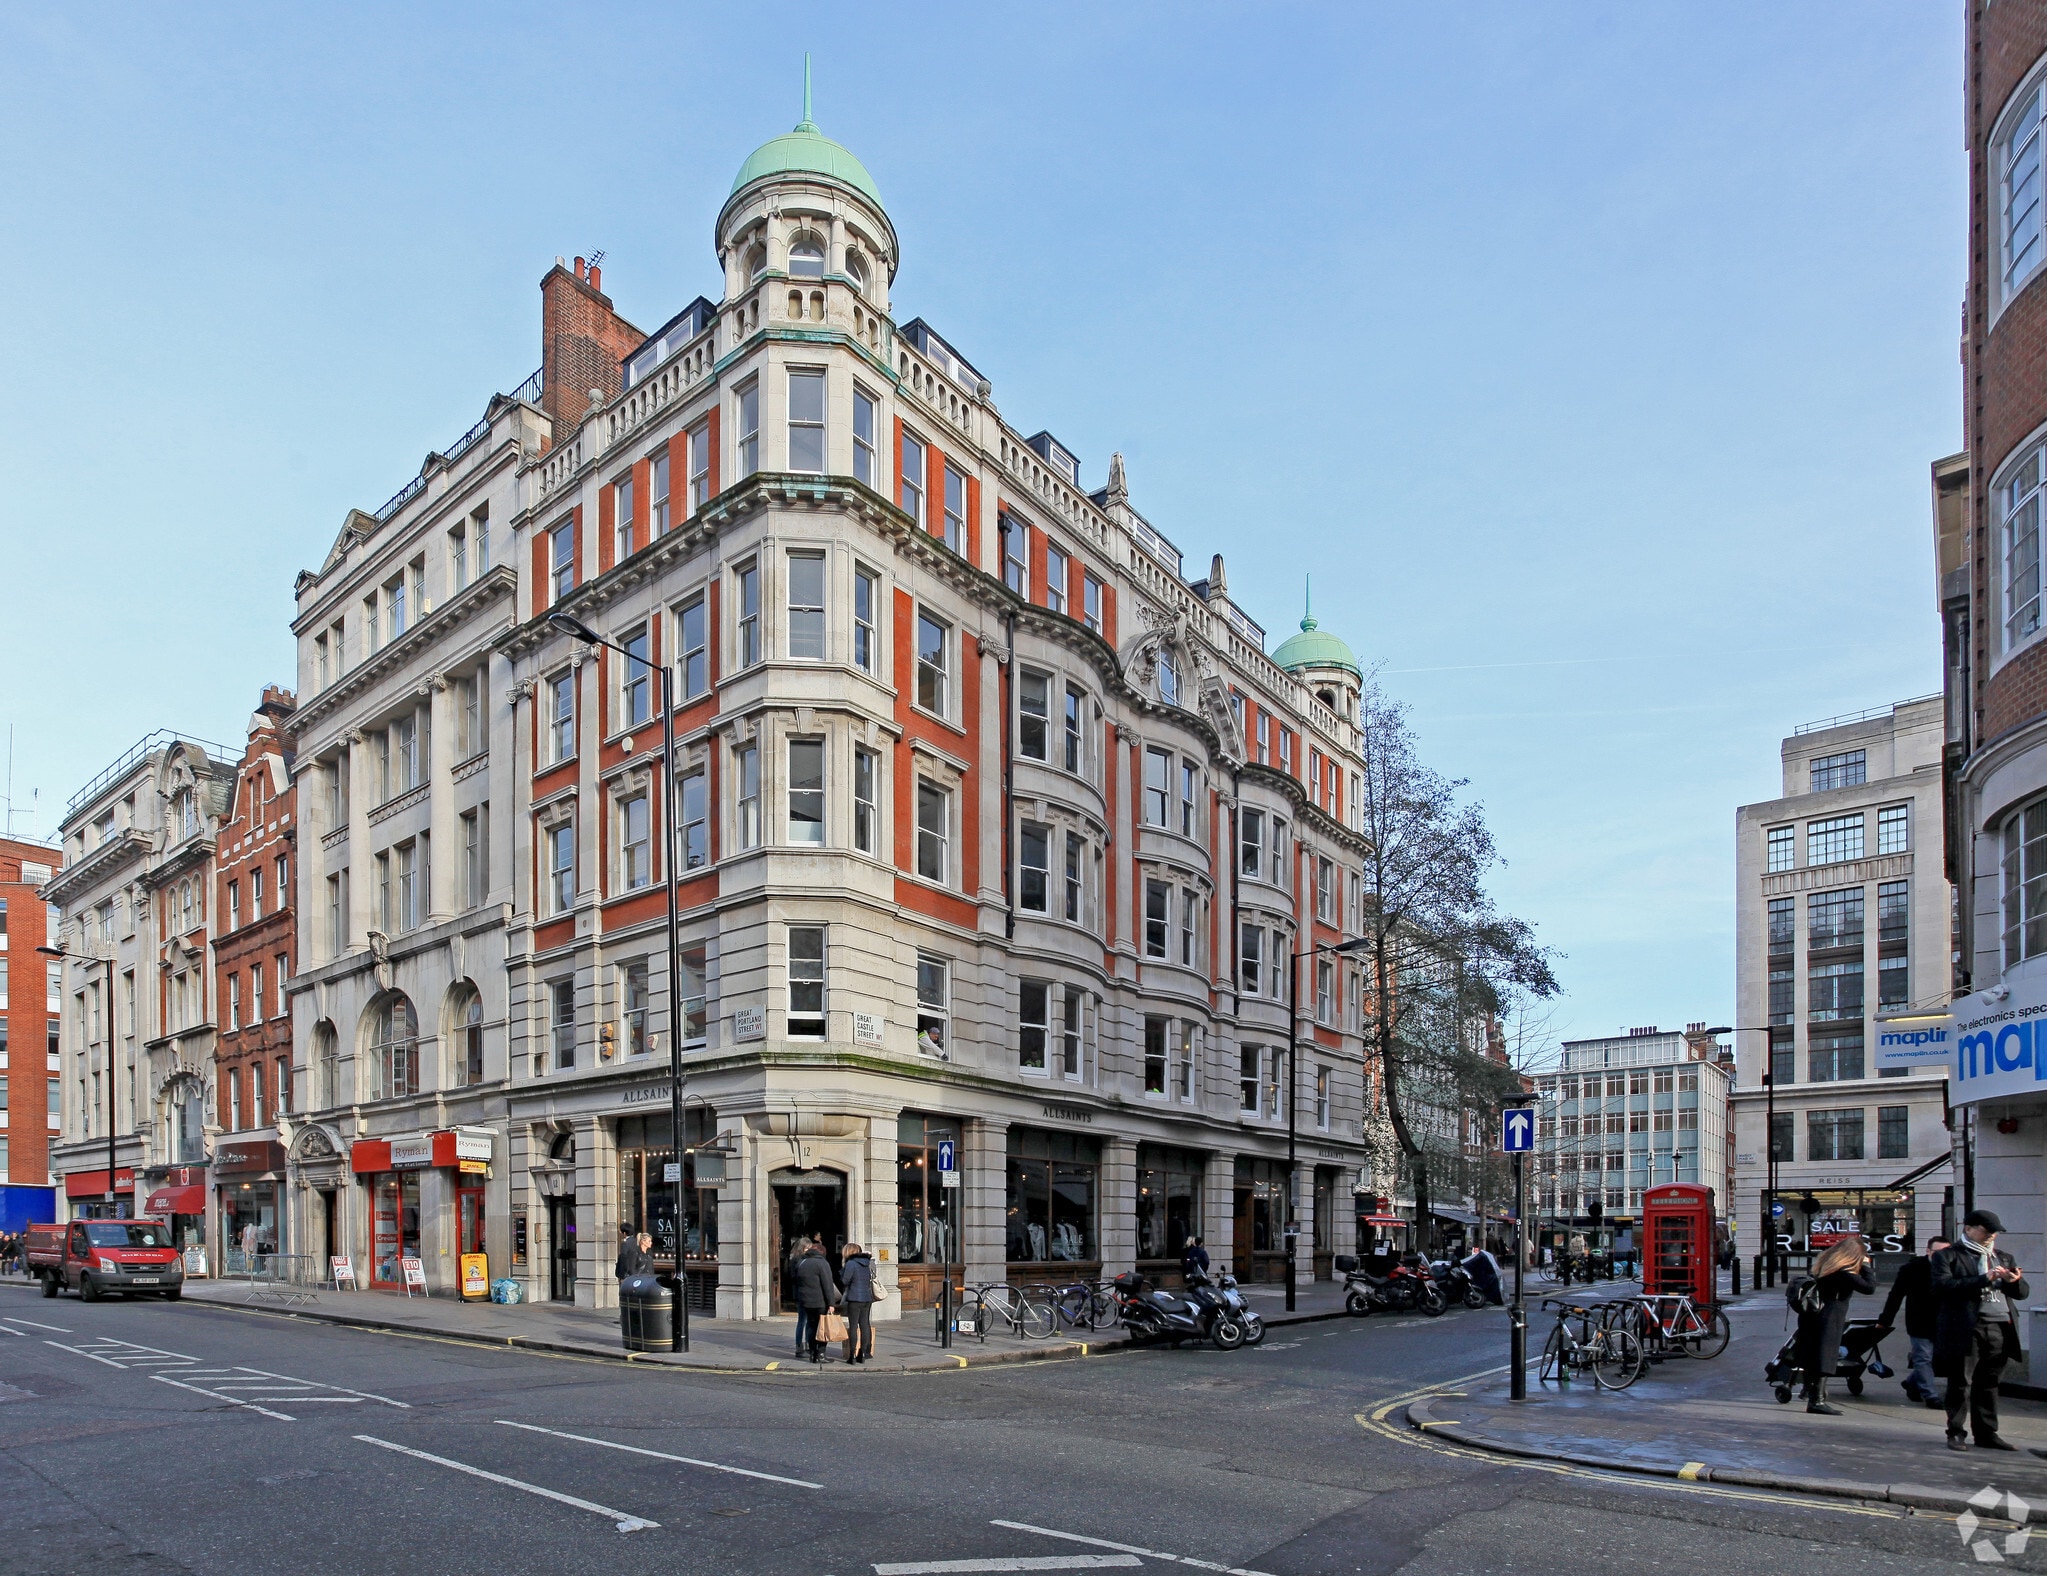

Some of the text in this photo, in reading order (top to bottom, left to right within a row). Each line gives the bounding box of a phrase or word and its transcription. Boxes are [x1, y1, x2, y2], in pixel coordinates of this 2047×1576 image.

[738, 1009, 752, 1018] GREAT
[857, 1014, 872, 1023] GREAT
[738, 1016, 761, 1026] PORTLAND
[1957, 1023, 1967, 1033] The
[1968, 1010, 2015, 1029] electronics
[739, 1025, 754, 1034] STREET
[857, 1022, 874, 1032] CASTLE
[858, 1030, 874, 1040] STREET
[1885, 1049, 1949, 1058] www.maplin.co.uk
[623, 1086, 673, 1103] ALLSAIN
[1042, 1106, 1092, 1123] ALLSAINTS
[458, 1140, 490, 1149] Ryman
[395, 1147, 428, 1159] Ryman
[803, 1147, 811, 1157] 12
[658, 1218, 689, 1232] SAE
[1811, 1221, 1860, 1232] SALE
